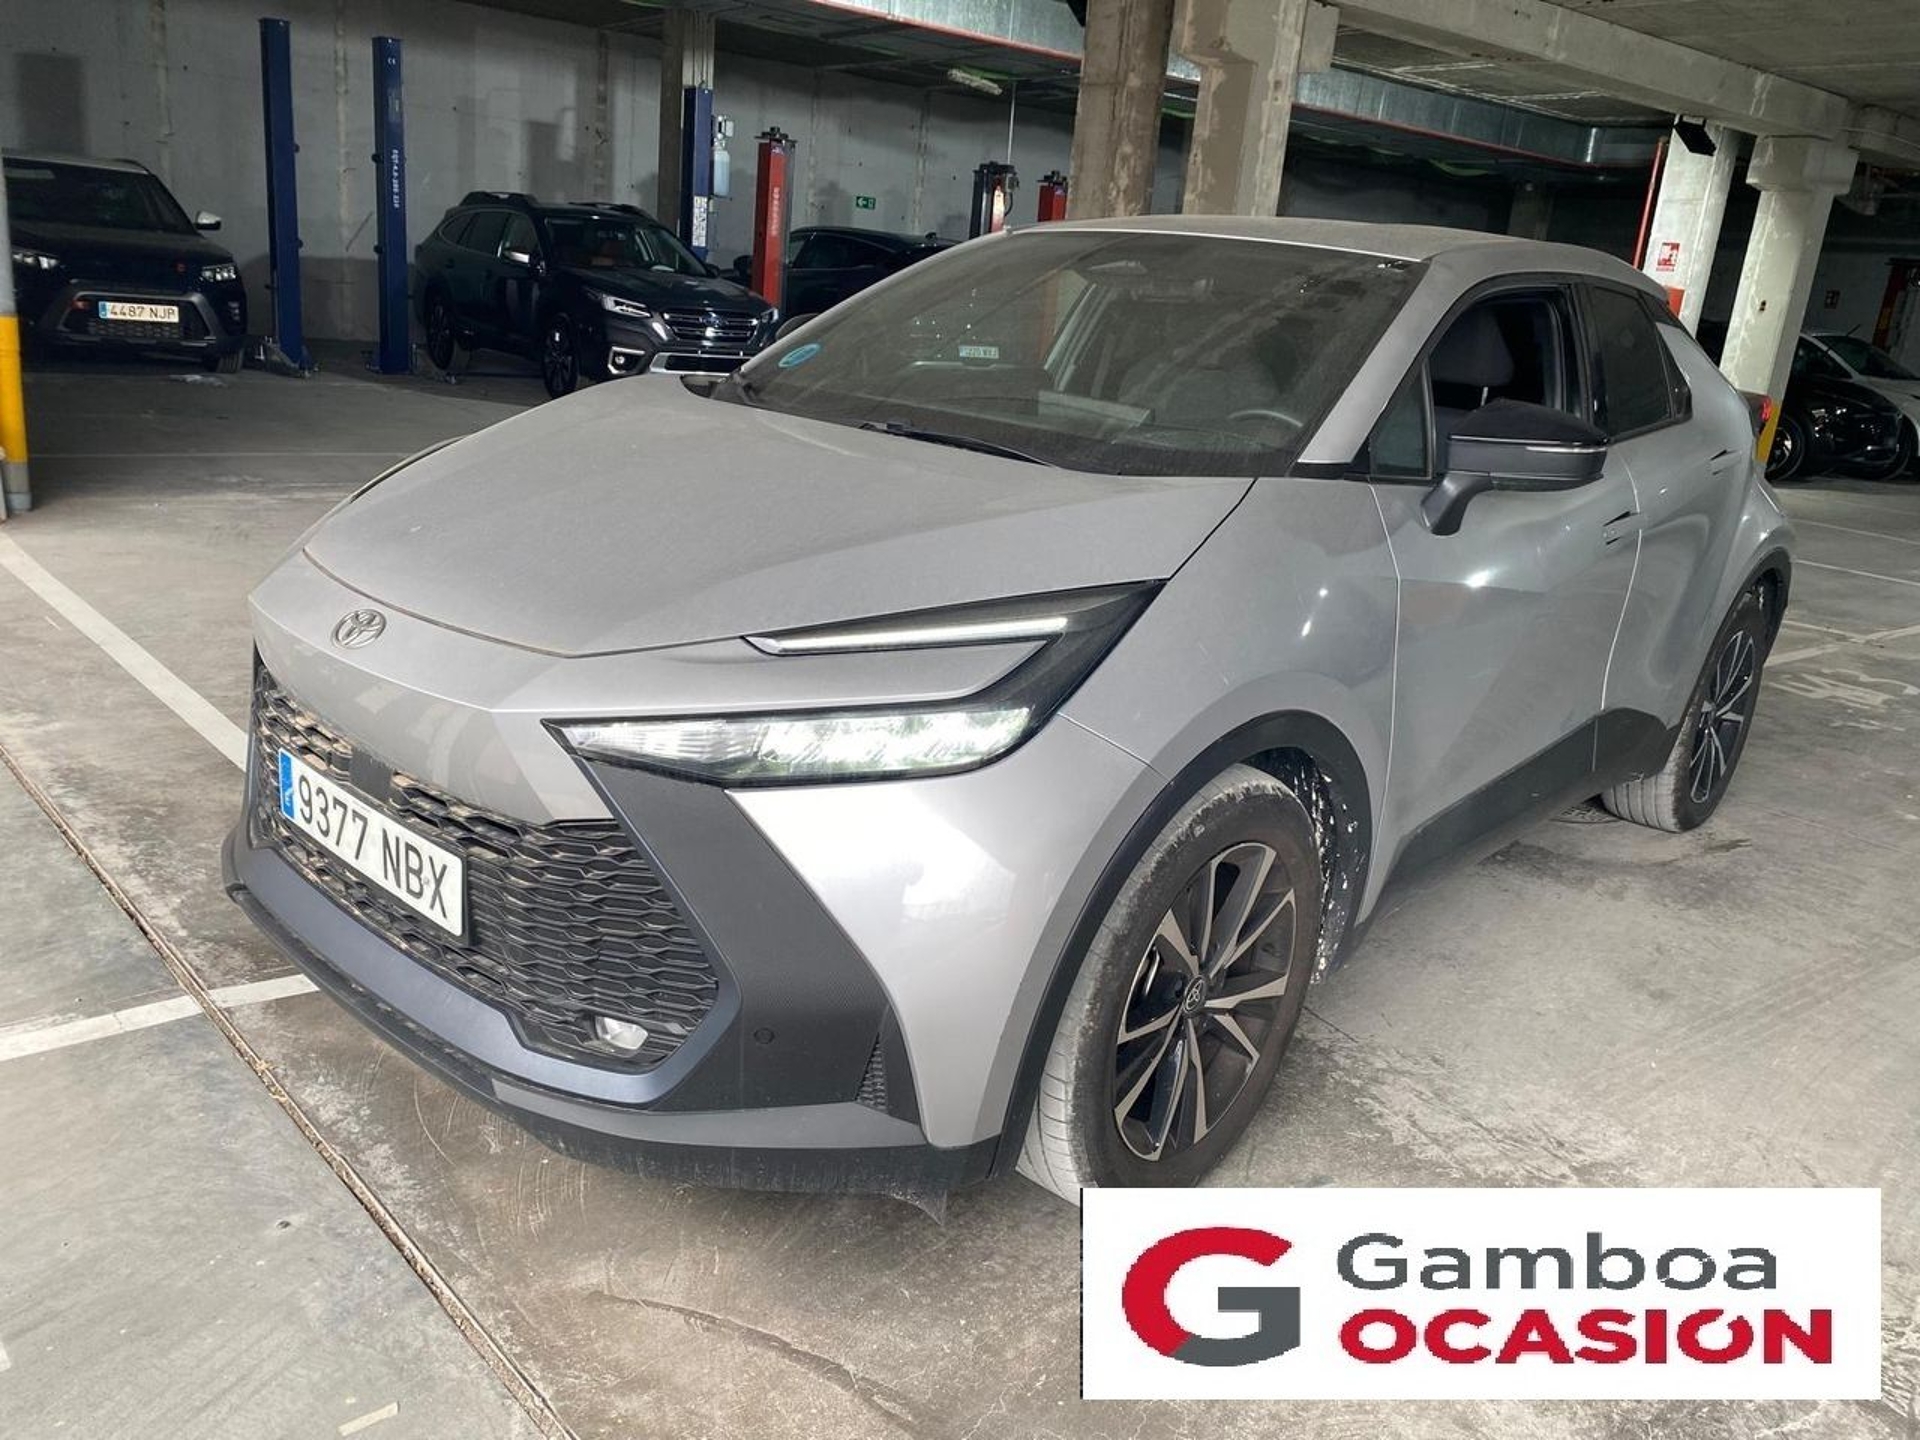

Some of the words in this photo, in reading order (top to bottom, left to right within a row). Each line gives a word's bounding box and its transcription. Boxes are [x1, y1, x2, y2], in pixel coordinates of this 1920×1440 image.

[110, 305, 145, 318] 4487
[149, 307, 176, 320] NJP
[299, 774, 369, 861] 9377
[382, 827, 448, 920] NBX
